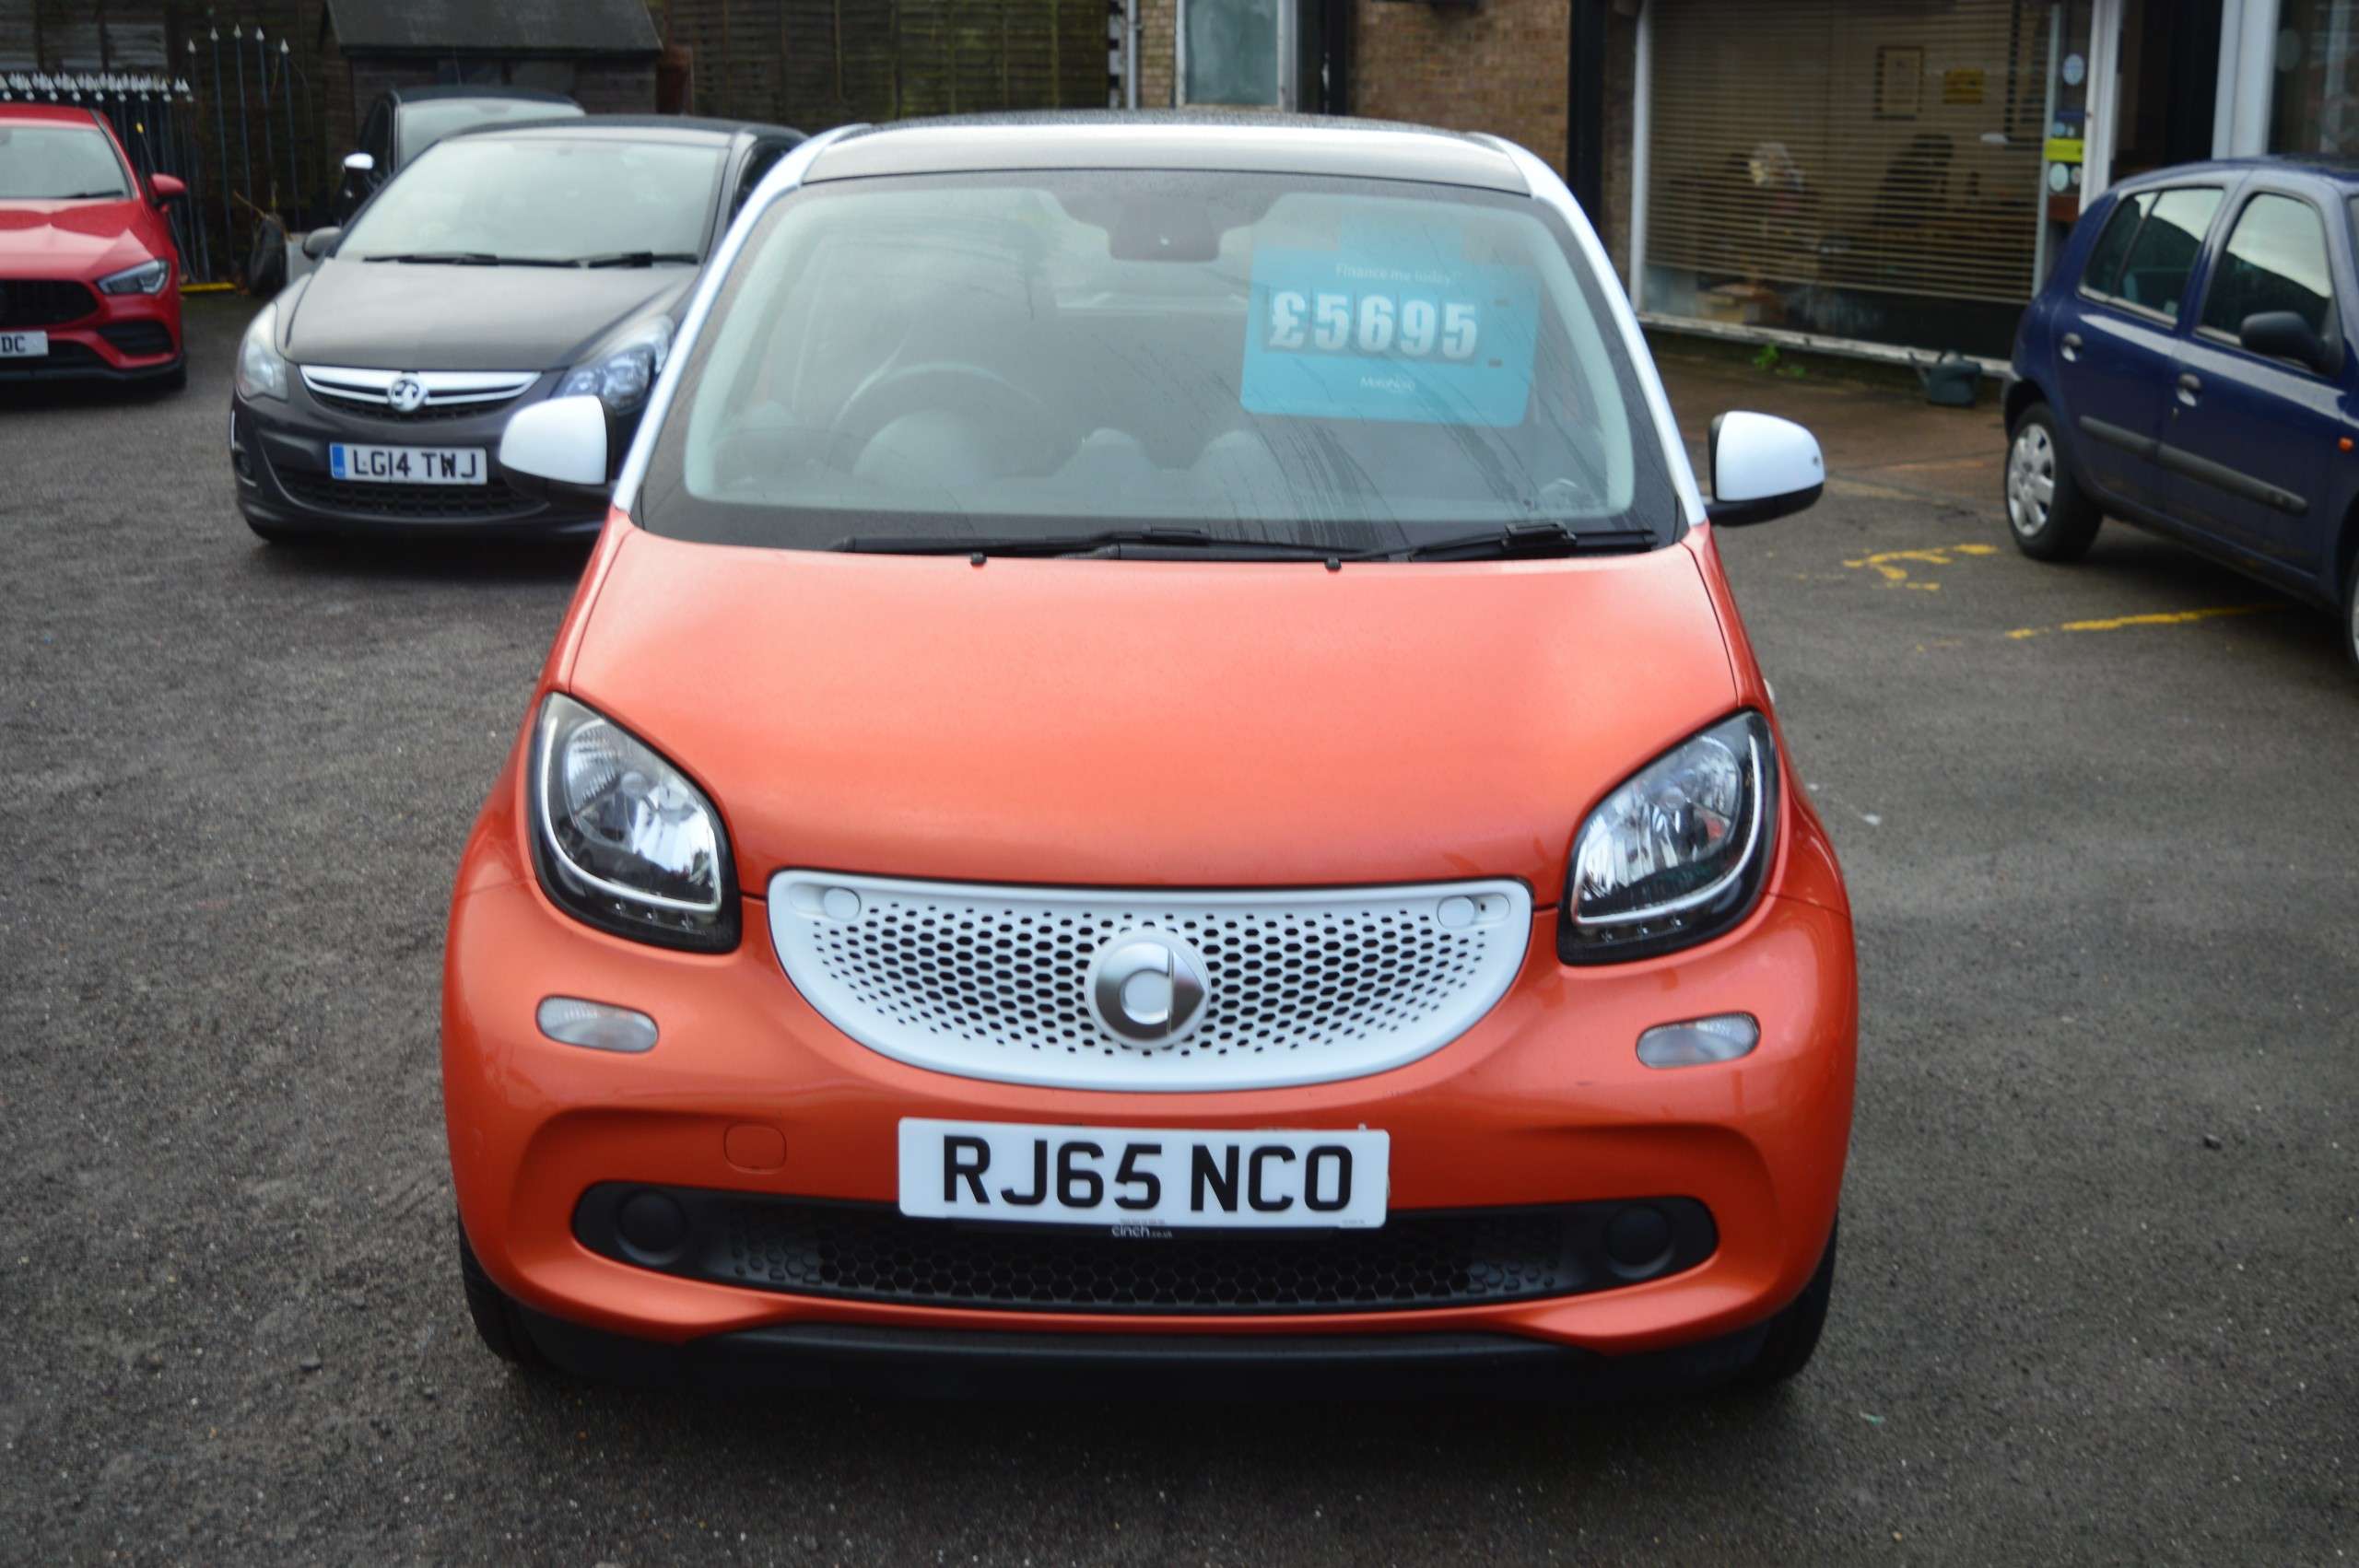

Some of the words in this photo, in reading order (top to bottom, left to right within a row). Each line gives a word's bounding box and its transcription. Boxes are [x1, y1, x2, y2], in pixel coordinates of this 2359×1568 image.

[1, 335, 26, 353] DC
[1269, 291, 1478, 360] £5695
[353, 449, 411, 477] LG14
[421, 451, 476, 478] TWJ
[943, 1134, 1163, 1211] RJ65
[1191, 1143, 1353, 1213] NCO
